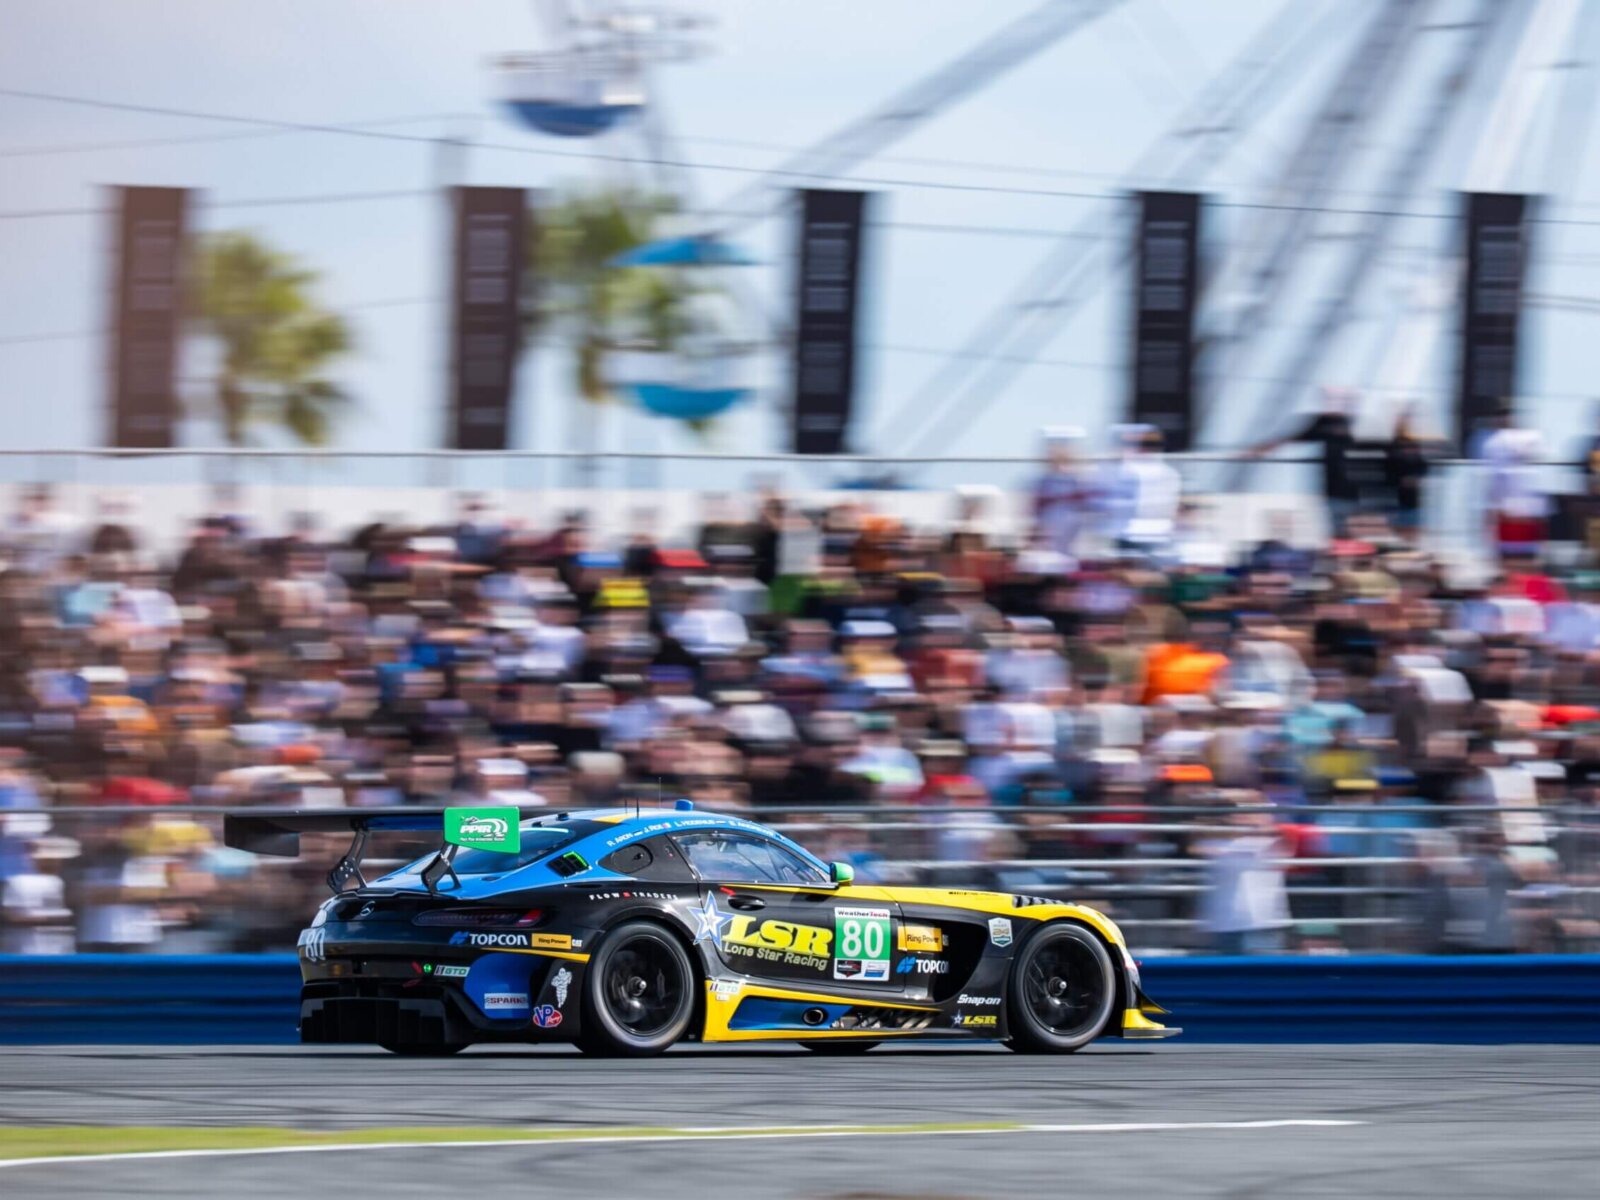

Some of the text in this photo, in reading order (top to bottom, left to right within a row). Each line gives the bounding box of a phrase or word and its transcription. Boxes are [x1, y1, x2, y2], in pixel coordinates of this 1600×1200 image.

[460, 825, 492, 834] PPIR
[589, 891, 679, 901] FLOW TRADERS
[469, 933, 528, 946] TOPCON
[721, 914, 834, 958] LSR
[842, 920, 884, 958] 80
[907, 934, 921, 944] Ring
[724, 942, 755, 957] Lone
[756, 948, 783, 961] Star
[784, 952, 828, 971] Racing
[957, 994, 1002, 1006] Snap-on
[533, 1005, 555, 1028] VP
[962, 1015, 998, 1025] LSR
